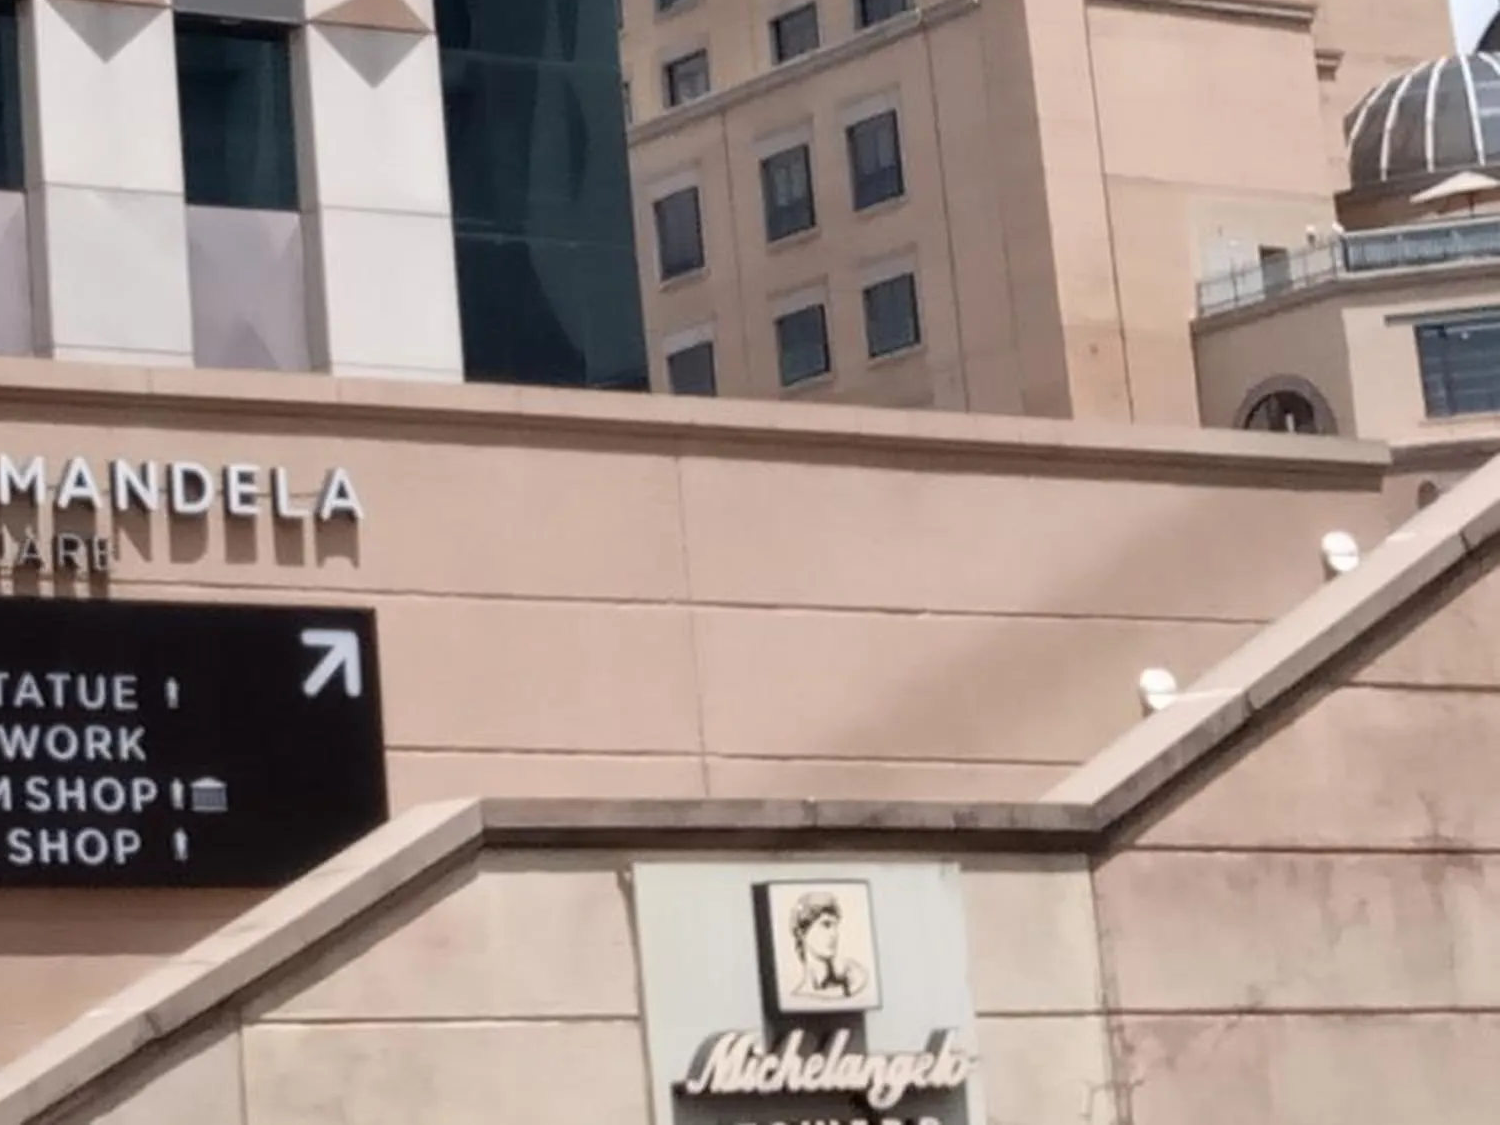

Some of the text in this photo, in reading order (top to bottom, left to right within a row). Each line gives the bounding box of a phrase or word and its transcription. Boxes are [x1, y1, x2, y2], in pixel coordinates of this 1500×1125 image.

[24, 776, 159, 813] SHOP
[6, 827, 142, 865] SHOP
[688, 1027, 980, 1111] Michelangelo
